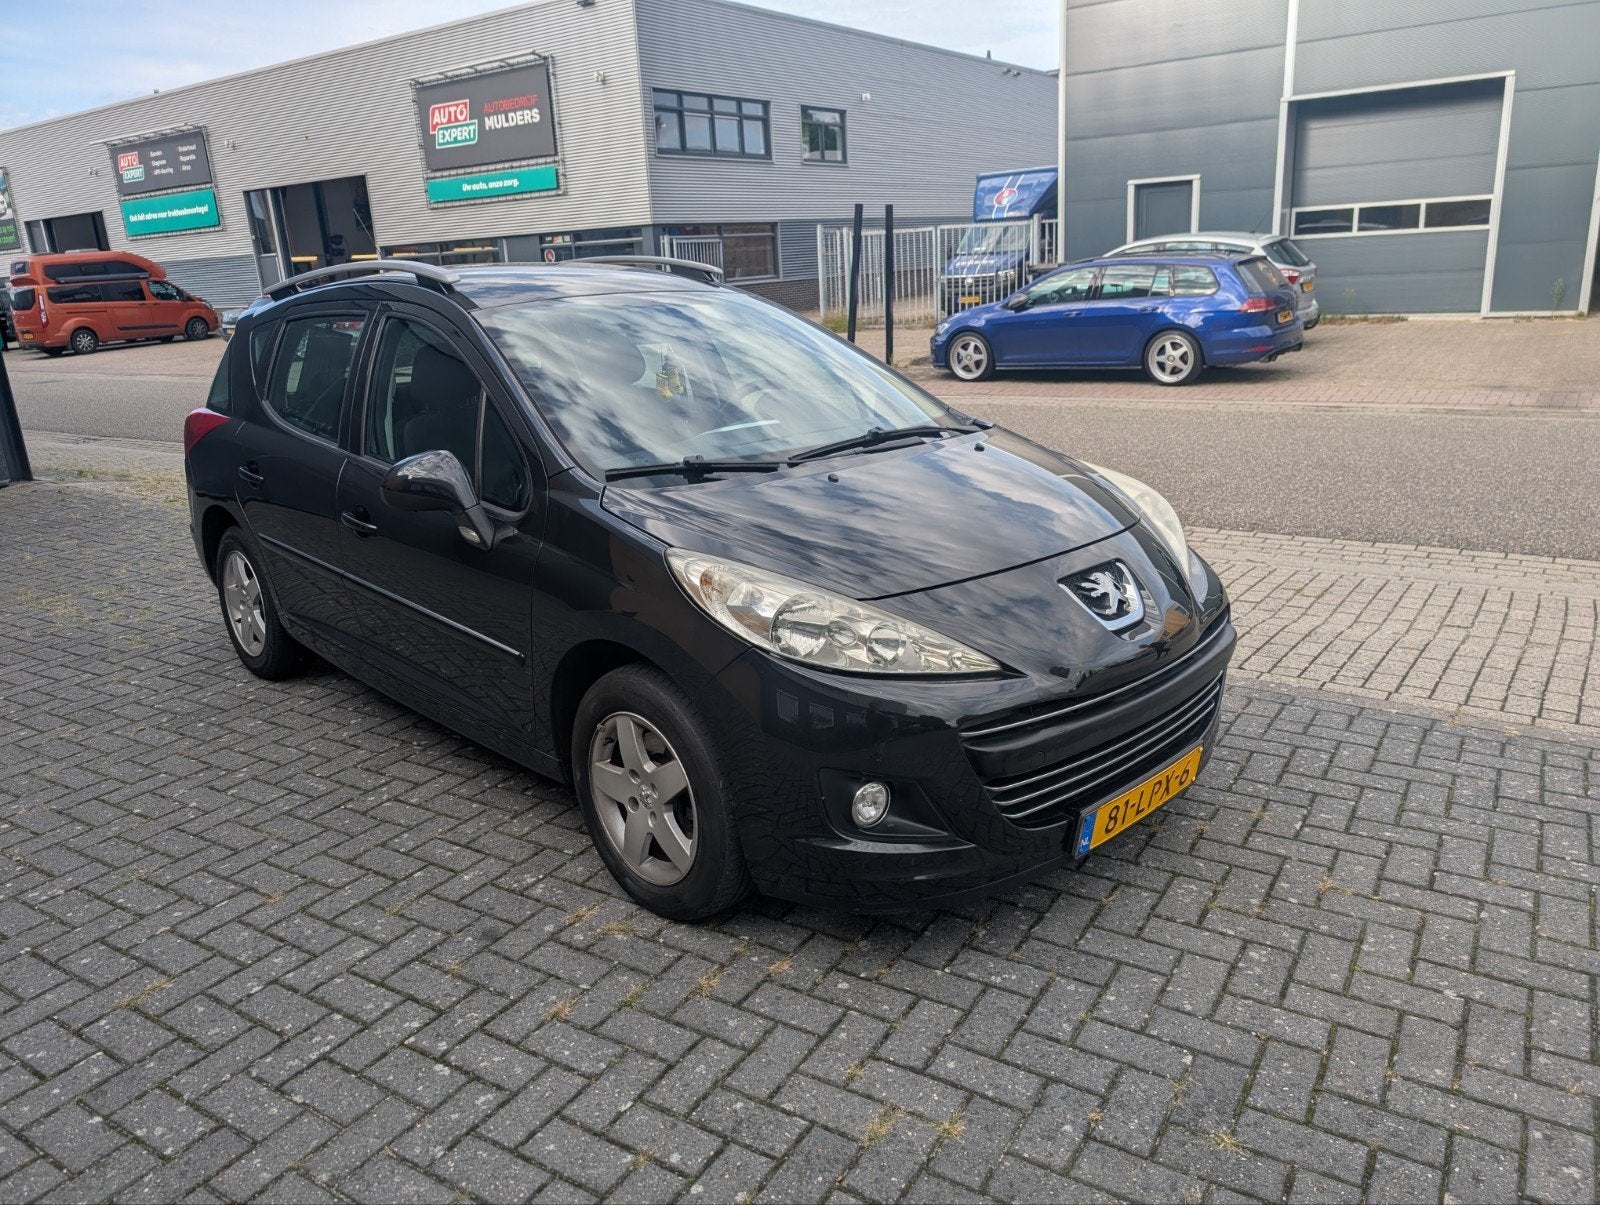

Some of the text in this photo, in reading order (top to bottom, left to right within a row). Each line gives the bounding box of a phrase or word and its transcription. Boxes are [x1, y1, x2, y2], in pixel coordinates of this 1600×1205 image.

[483, 94, 538, 114] AUTOBEDRIJF
[433, 105, 466, 125] AUTO
[484, 108, 541, 131] MULDERS
[438, 125, 476, 144] EXPERT
[120, 155, 137, 167] AUTO
[124, 168, 143, 179] EXPERT
[462, 178, 520, 192] Uw auto, onze zorg.
[1104, 760, 1190, 834] 81-LPX-6
[1081, 836, 1091, 847] NL
